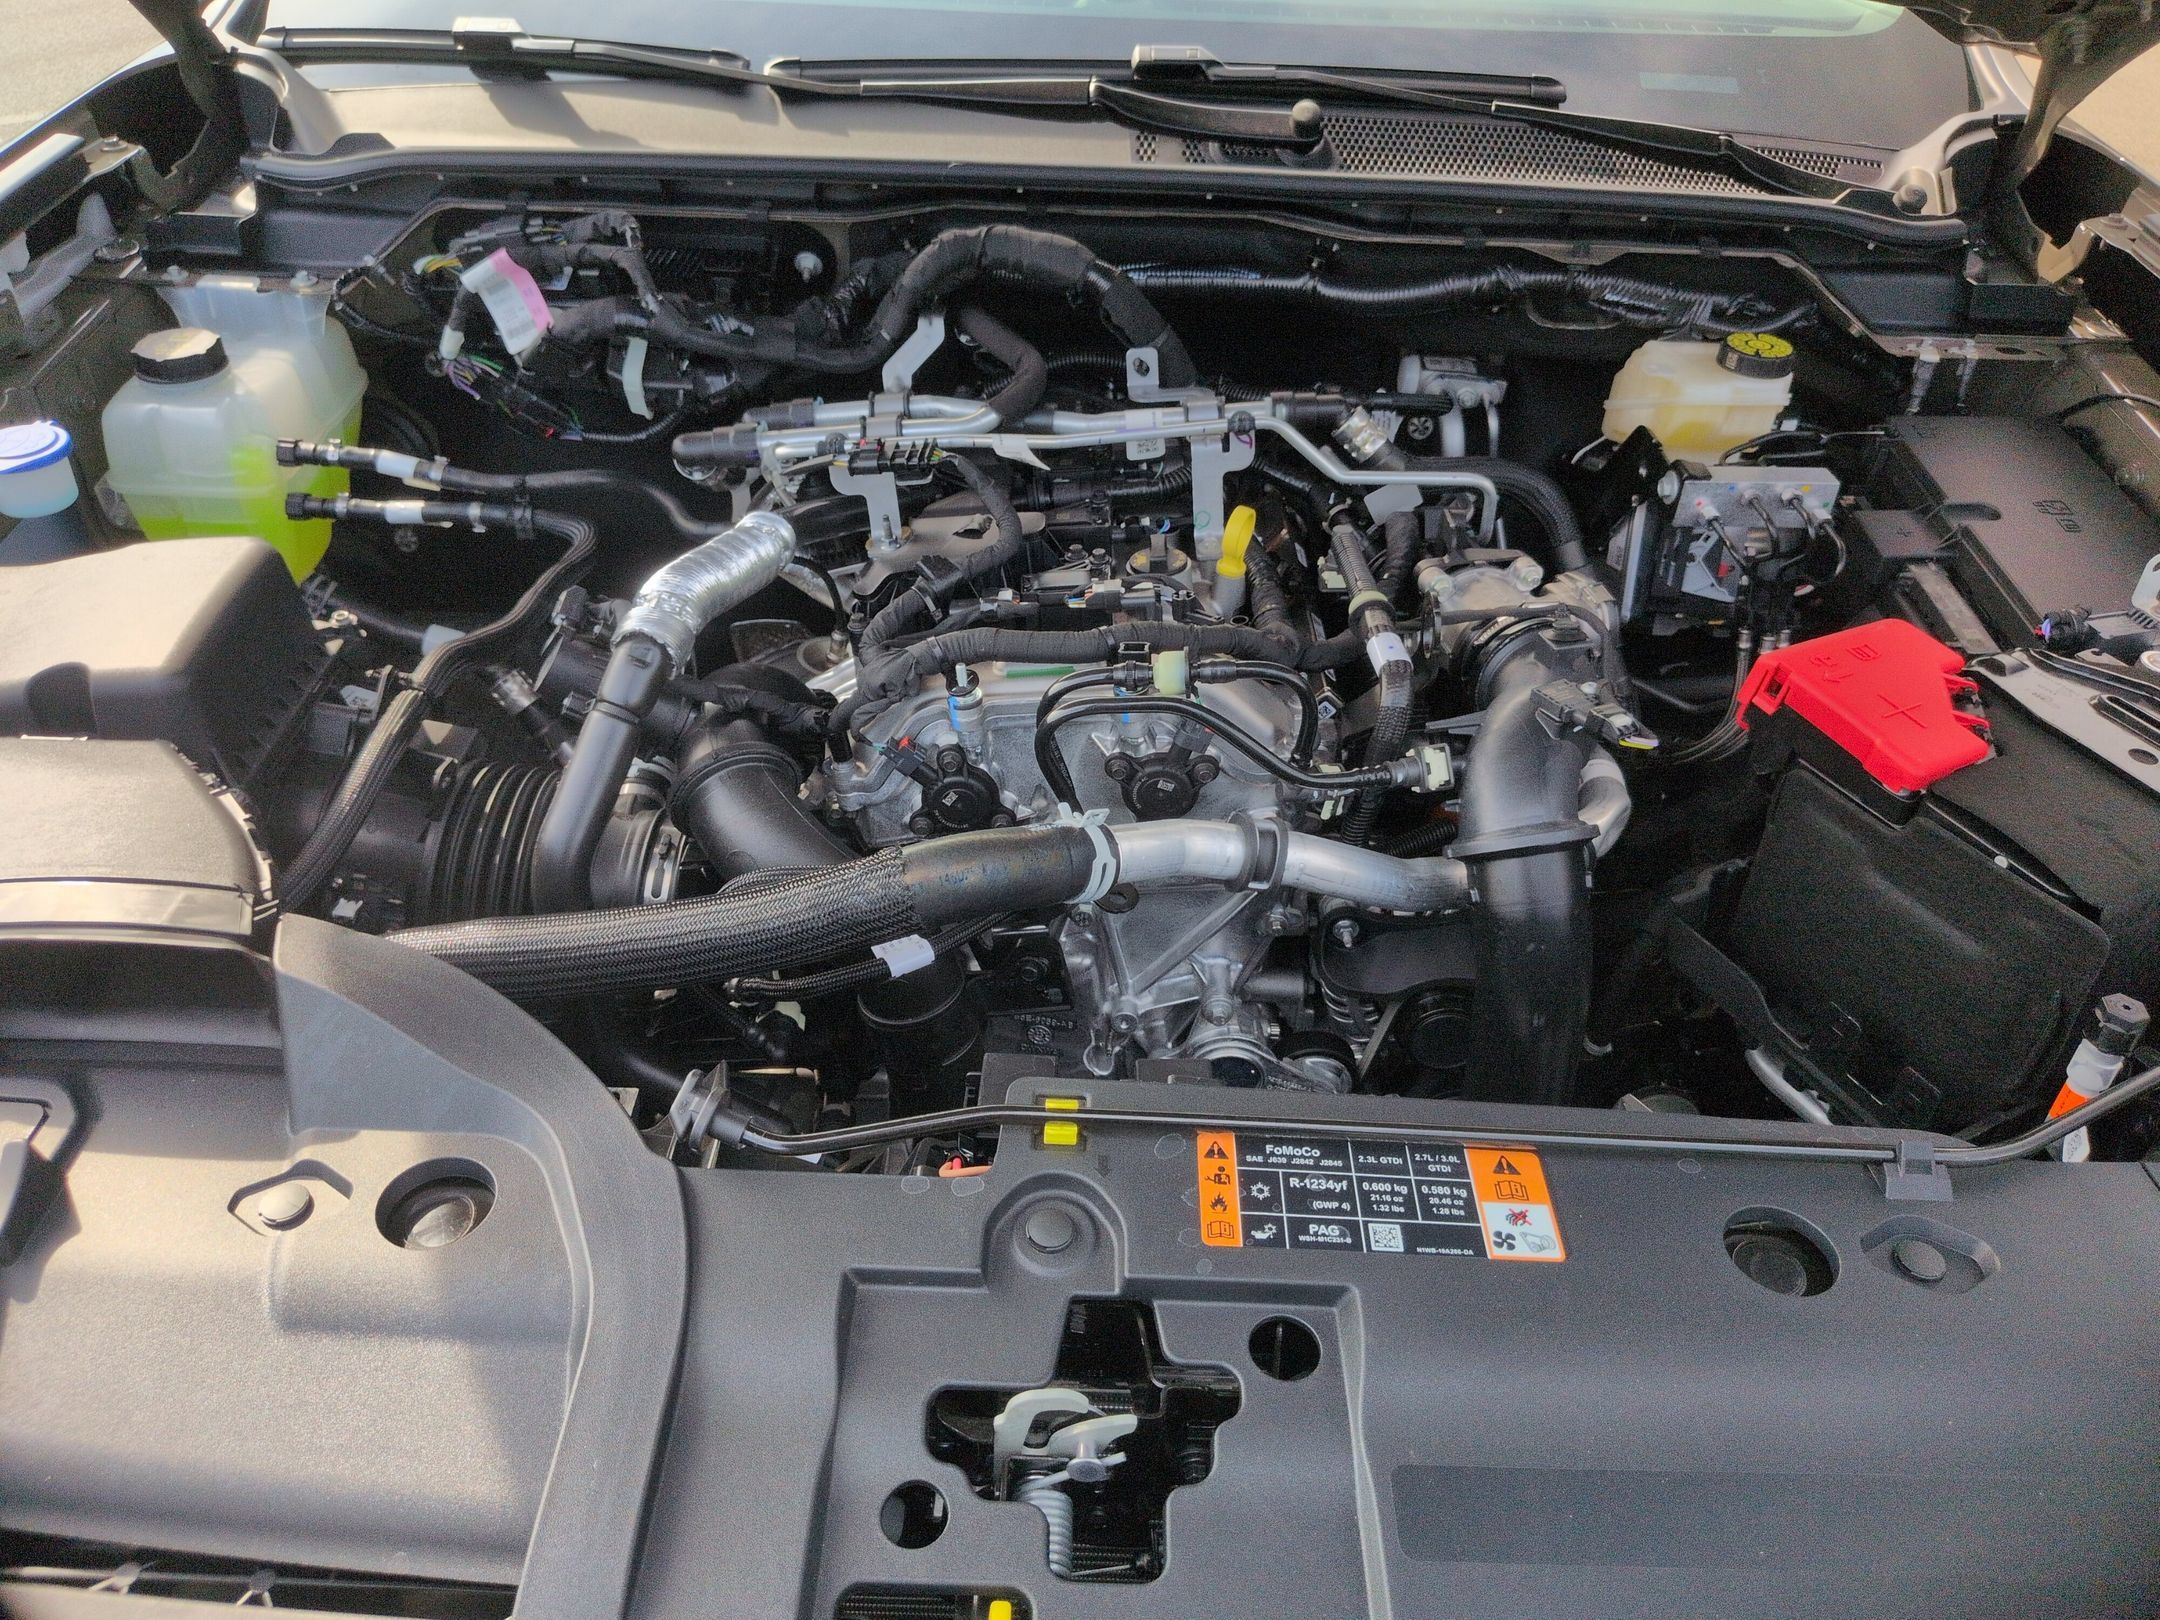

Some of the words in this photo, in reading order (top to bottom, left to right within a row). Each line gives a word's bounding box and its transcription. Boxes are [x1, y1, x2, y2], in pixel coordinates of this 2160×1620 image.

[1265, 1144, 1320, 1157] FoMoCo
[1245, 1155, 1264, 1163] SAE
[1319, 1159, 1343, 1167] J2845
[1358, 1155, 1378, 1164] 2.3L
[1380, 1156, 1403, 1165] GTDI
[1414, 1153, 1434, 1162] 2.7L
[1440, 1155, 1460, 1163] 3.0L
[1428, 1164, 1451, 1173] GTDI
[1289, 1177, 1348, 1193] R-1234yf
[1362, 1181, 1391, 1192] 0.600
[1393, 1183, 1408, 1194] kg
[1421, 1185, 1451, 1195] 0.580
[1453, 1186, 1468, 1198] kg
[1370, 1193, 1391, 1202] 21.16
[1428, 1197, 1452, 1205] 20.46
[1312, 1200, 1339, 1211] (GWP
[1341, 1202, 1351, 1211] 4)
[1372, 1204, 1390, 1212] 1.32
[1391, 1205, 1405, 1213] lbs
[1432, 1207, 1450, 1215] 1.28
[1451, 1208, 1465, 1216] lbs
[1309, 1223, 1340, 1236] PAG
